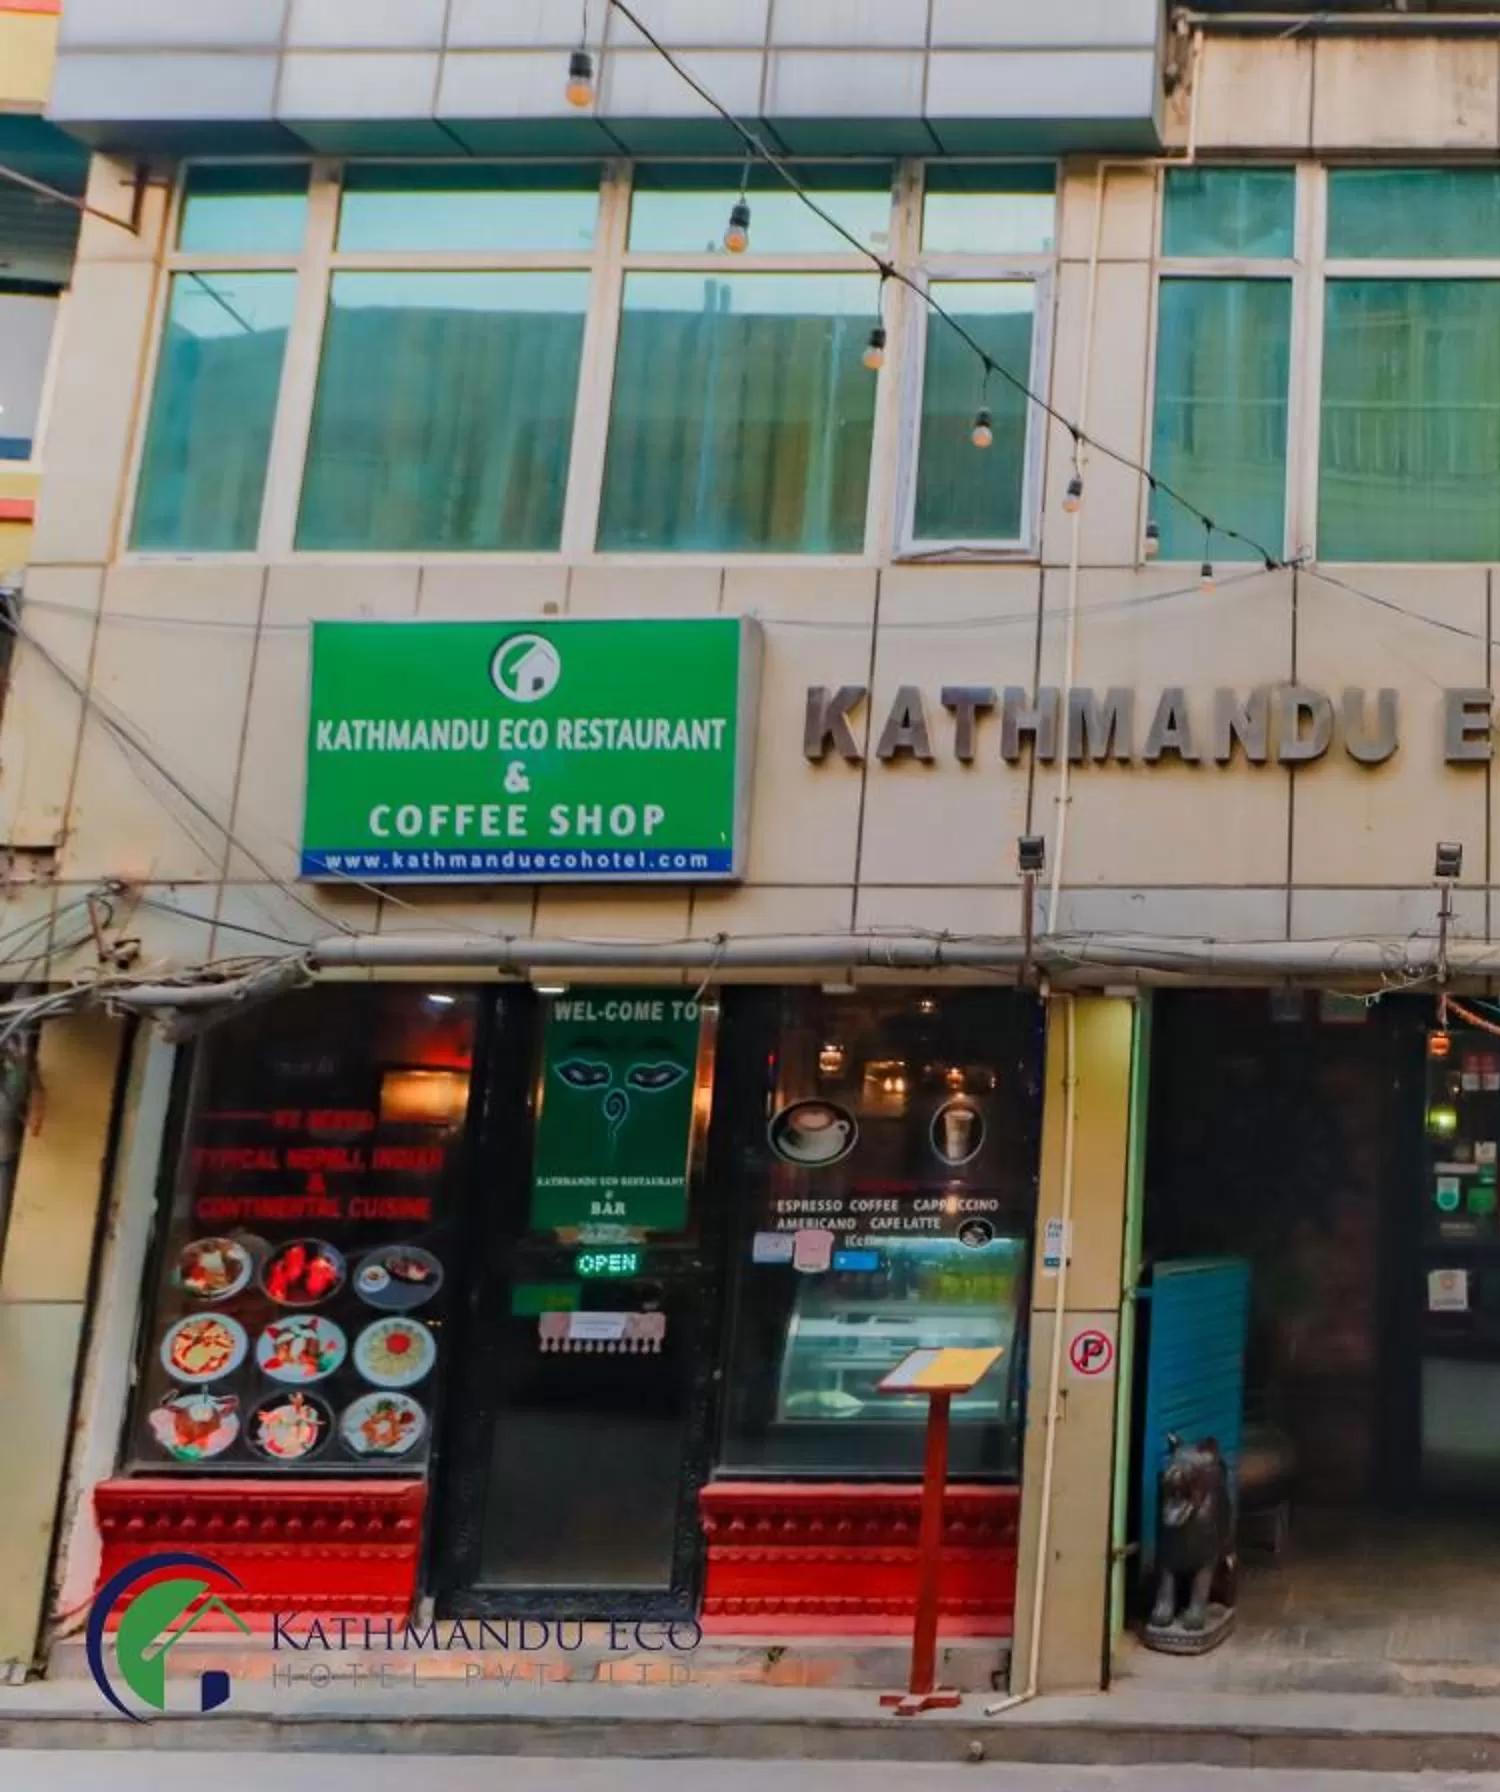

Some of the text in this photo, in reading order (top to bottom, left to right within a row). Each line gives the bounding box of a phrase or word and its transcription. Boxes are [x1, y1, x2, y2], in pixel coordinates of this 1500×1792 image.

[316, 718, 727, 751] KATHMANDU ECO RESTAURANT
[802, 684, 1399, 766] KATHMANDU
[503, 761, 531, 793] &
[368, 803, 666, 837] COFFEE SHOP
[325, 850, 710, 870] www.kathmanduecohotel.com
[554, 1000, 699, 1022] WEL-COME TO
[590, 1201, 626, 1216] BAR
[777, 1199, 1000, 1213] ESPRESSO COFFEE CAPPCCINO
[776, 1216, 857, 1231] AMERICANO
[577, 1252, 638, 1273] OPEN
[1082, 1339, 1104, 1368] P
